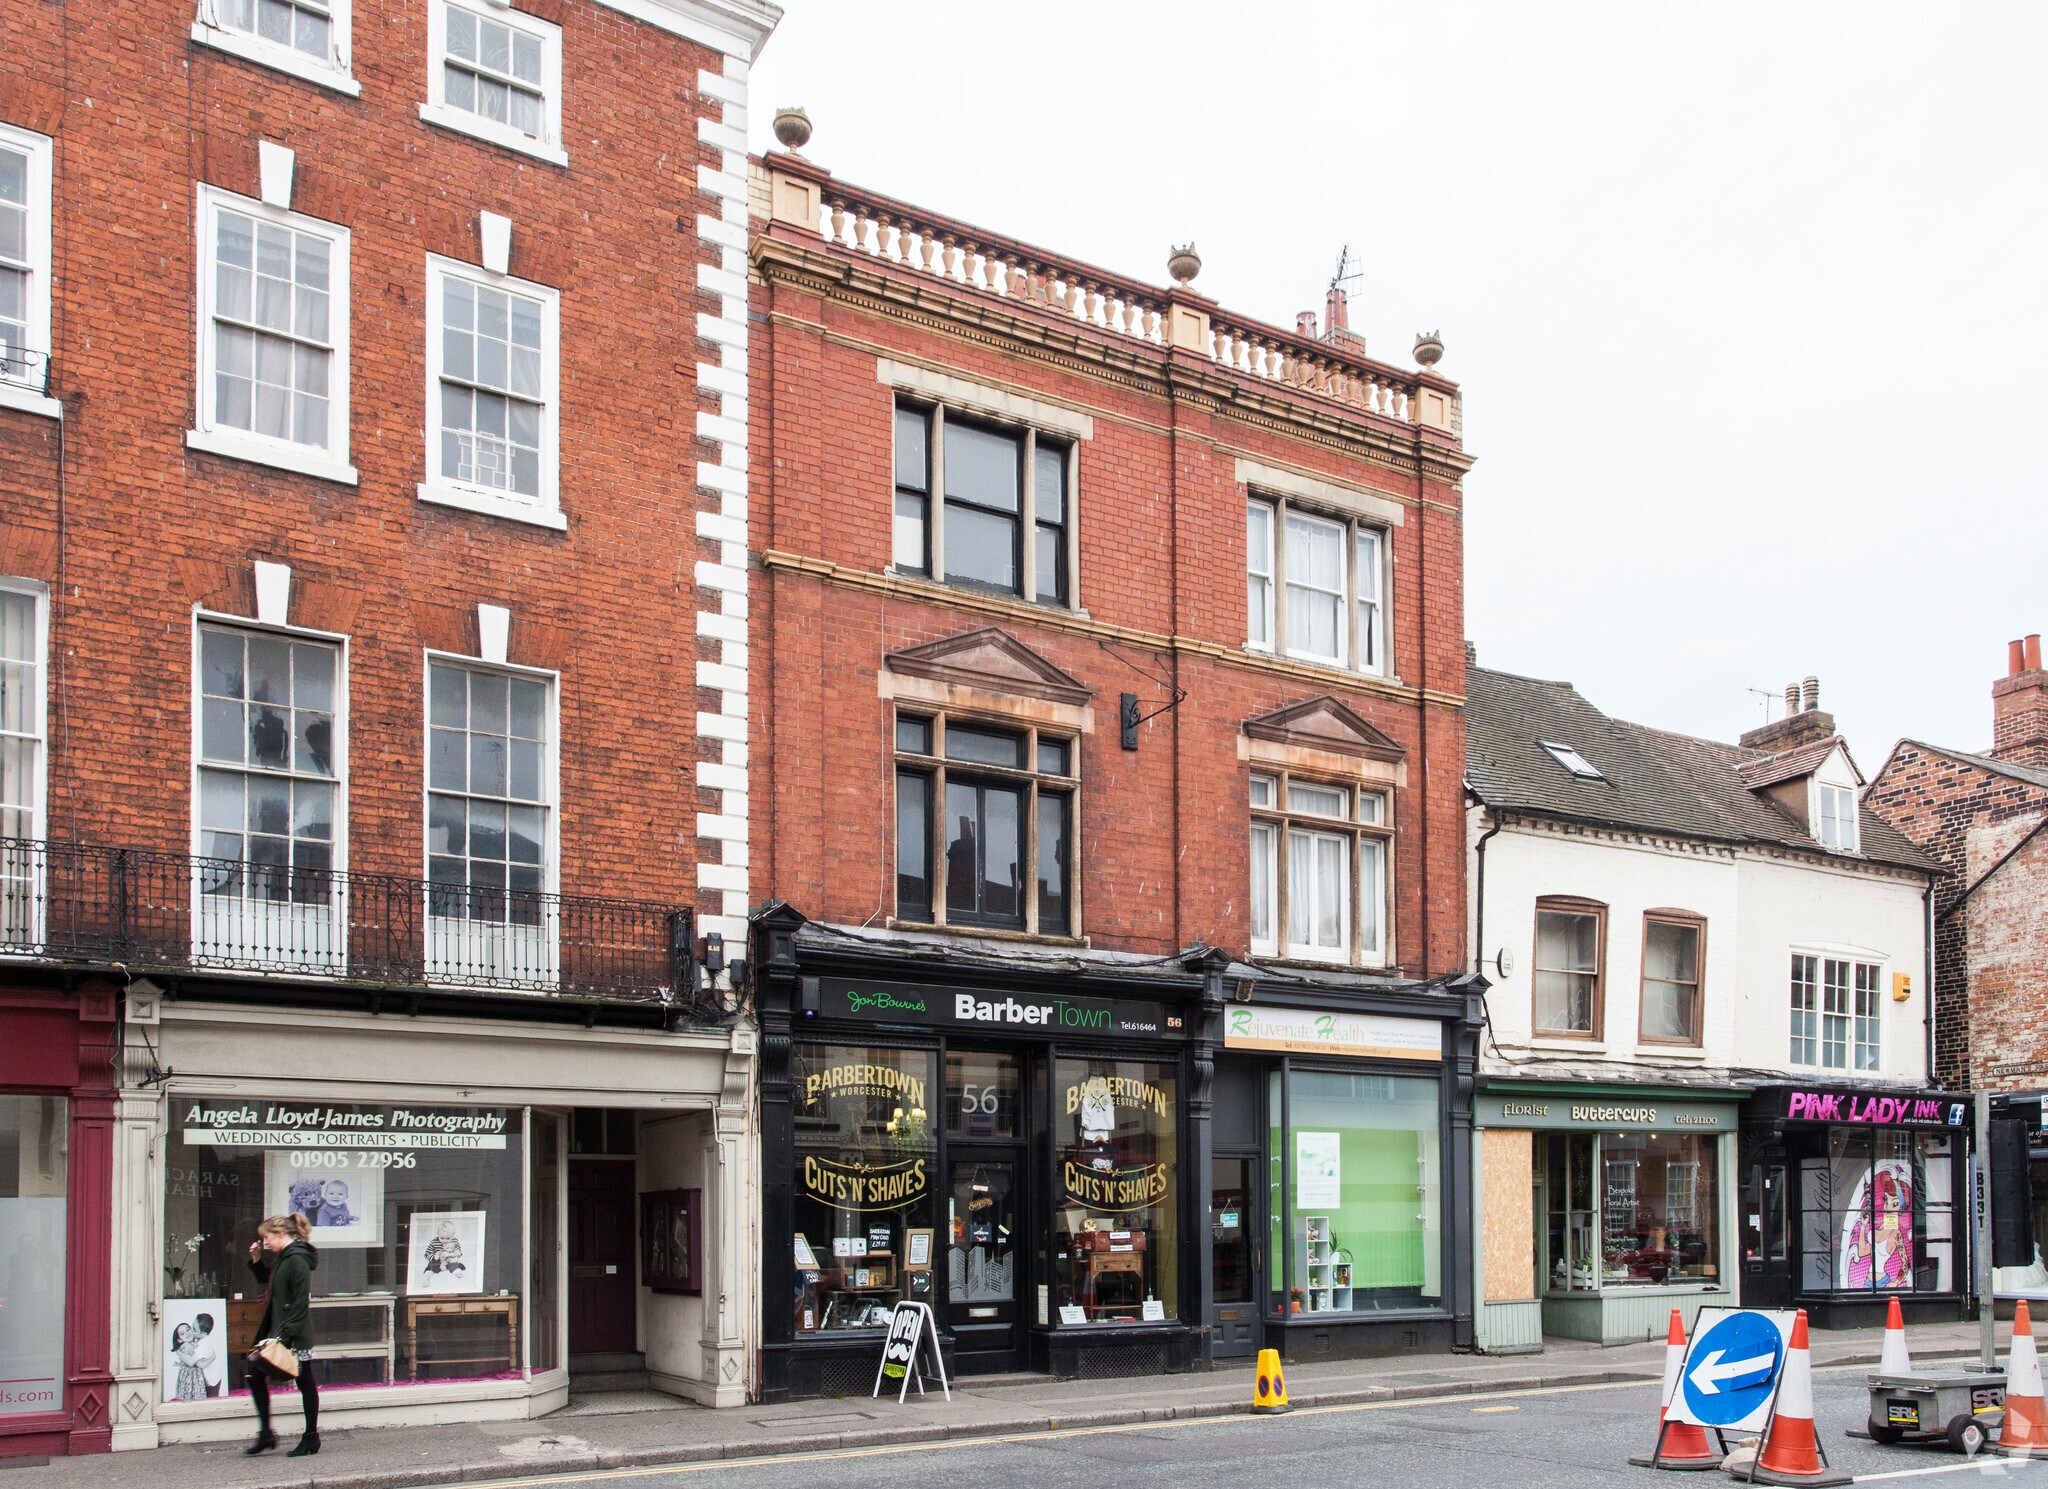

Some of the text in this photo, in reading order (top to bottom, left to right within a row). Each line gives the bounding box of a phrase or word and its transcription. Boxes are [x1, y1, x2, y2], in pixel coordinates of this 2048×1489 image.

[1167, 1017, 1183, 1029] 56
[1230, 1010, 1365, 1043] Rejuvenate Health
[807, 1064, 925, 1109] BARBERTOWN
[839, 1087, 892, 1099] WORCESTER
[961, 1084, 999, 1114] 56
[185, 1105, 507, 1133] Angela Lloyd-James Photography
[1788, 1092, 1943, 1124] PINK LADY INK
[215, 1131, 482, 1147] WEDDINGS PORTRAITS PUBLICITY
[290, 1151, 417, 1169] 01905 22956
[805, 1155, 847, 1200] CUTS
[868, 1158, 926, 1203] SHAVES
[1065, 1161, 1100, 1201] CUTS
[1118, 1162, 1167, 1204] SHAVES
[1608, 1184, 1635, 1196] Bespoke
[1622, 1197, 1640, 1207] Artist
[1976, 1172, 1985, 1229] B331
[893, 1309, 920, 1342] OPEN
[1889, 1406, 1918, 1419] SRL
